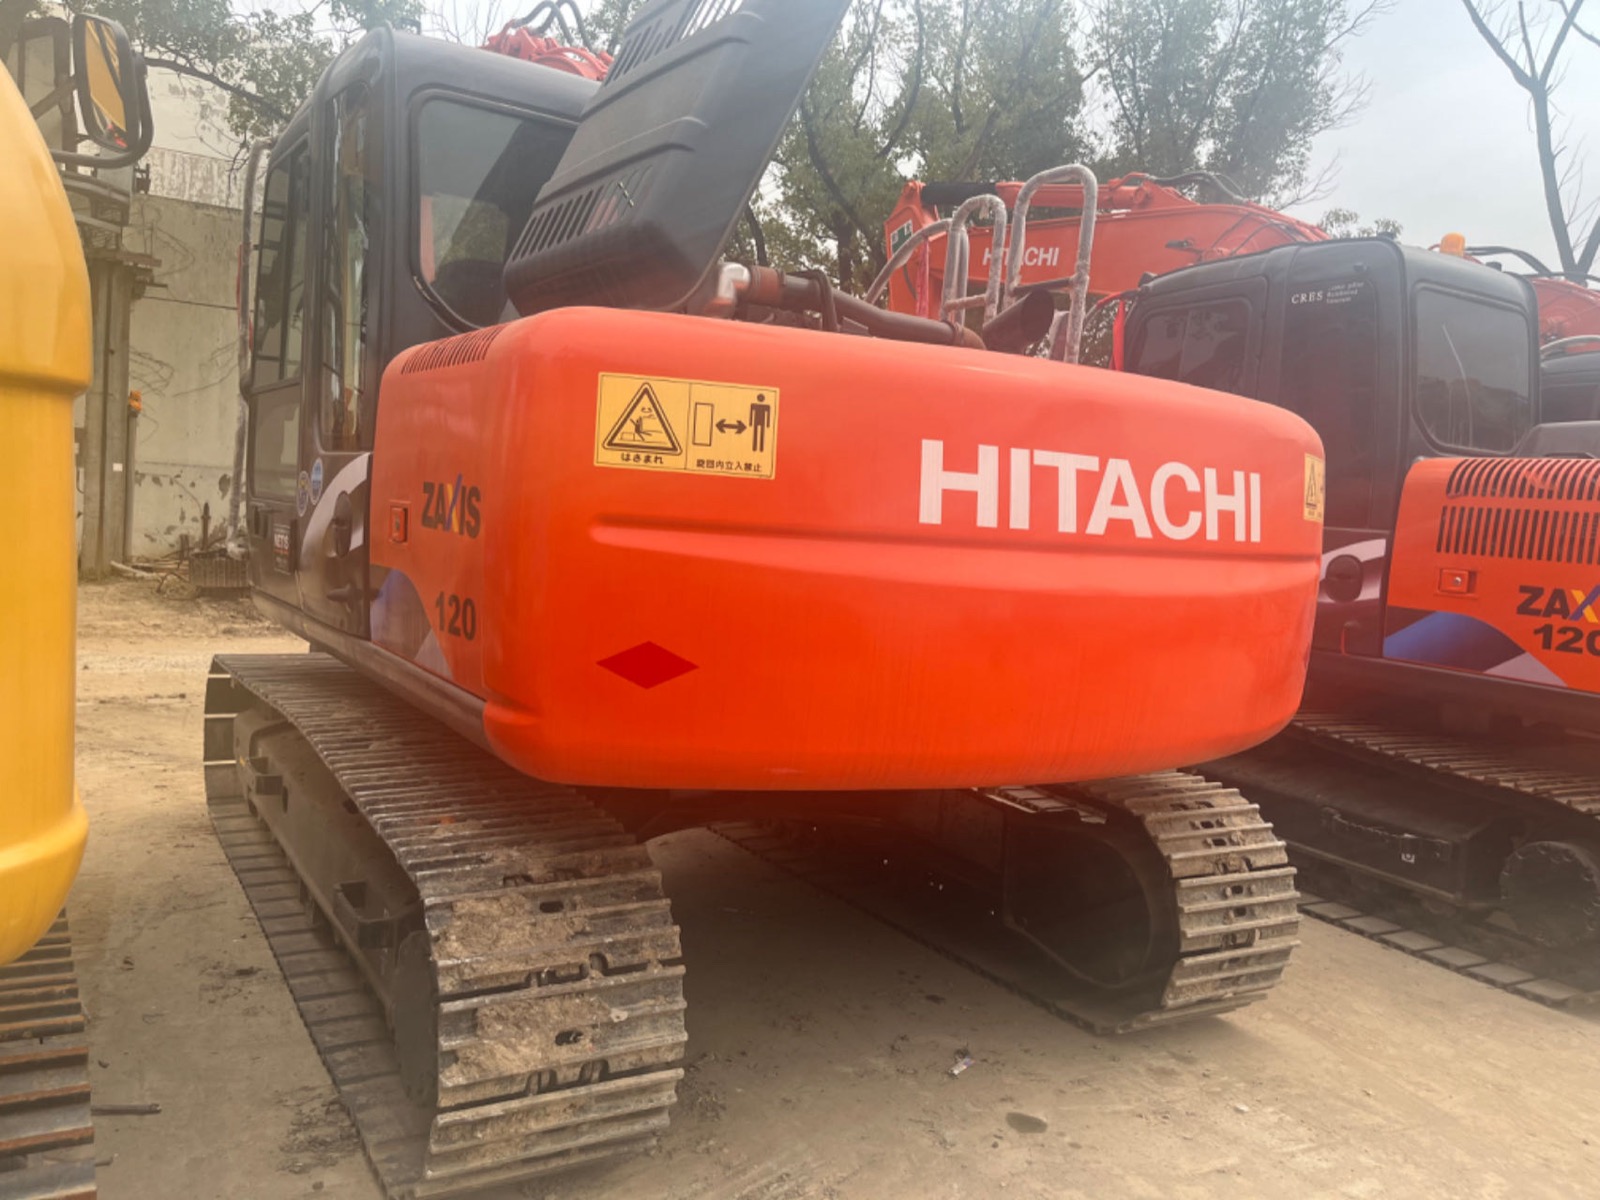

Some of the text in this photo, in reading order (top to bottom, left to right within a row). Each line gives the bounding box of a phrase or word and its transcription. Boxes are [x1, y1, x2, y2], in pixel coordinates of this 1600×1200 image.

[1291, 290, 1323, 304] CRES
[421, 473, 481, 539] ZAXIS
[919, 438, 1261, 543] HITACHI
[436, 591, 476, 641] 120
